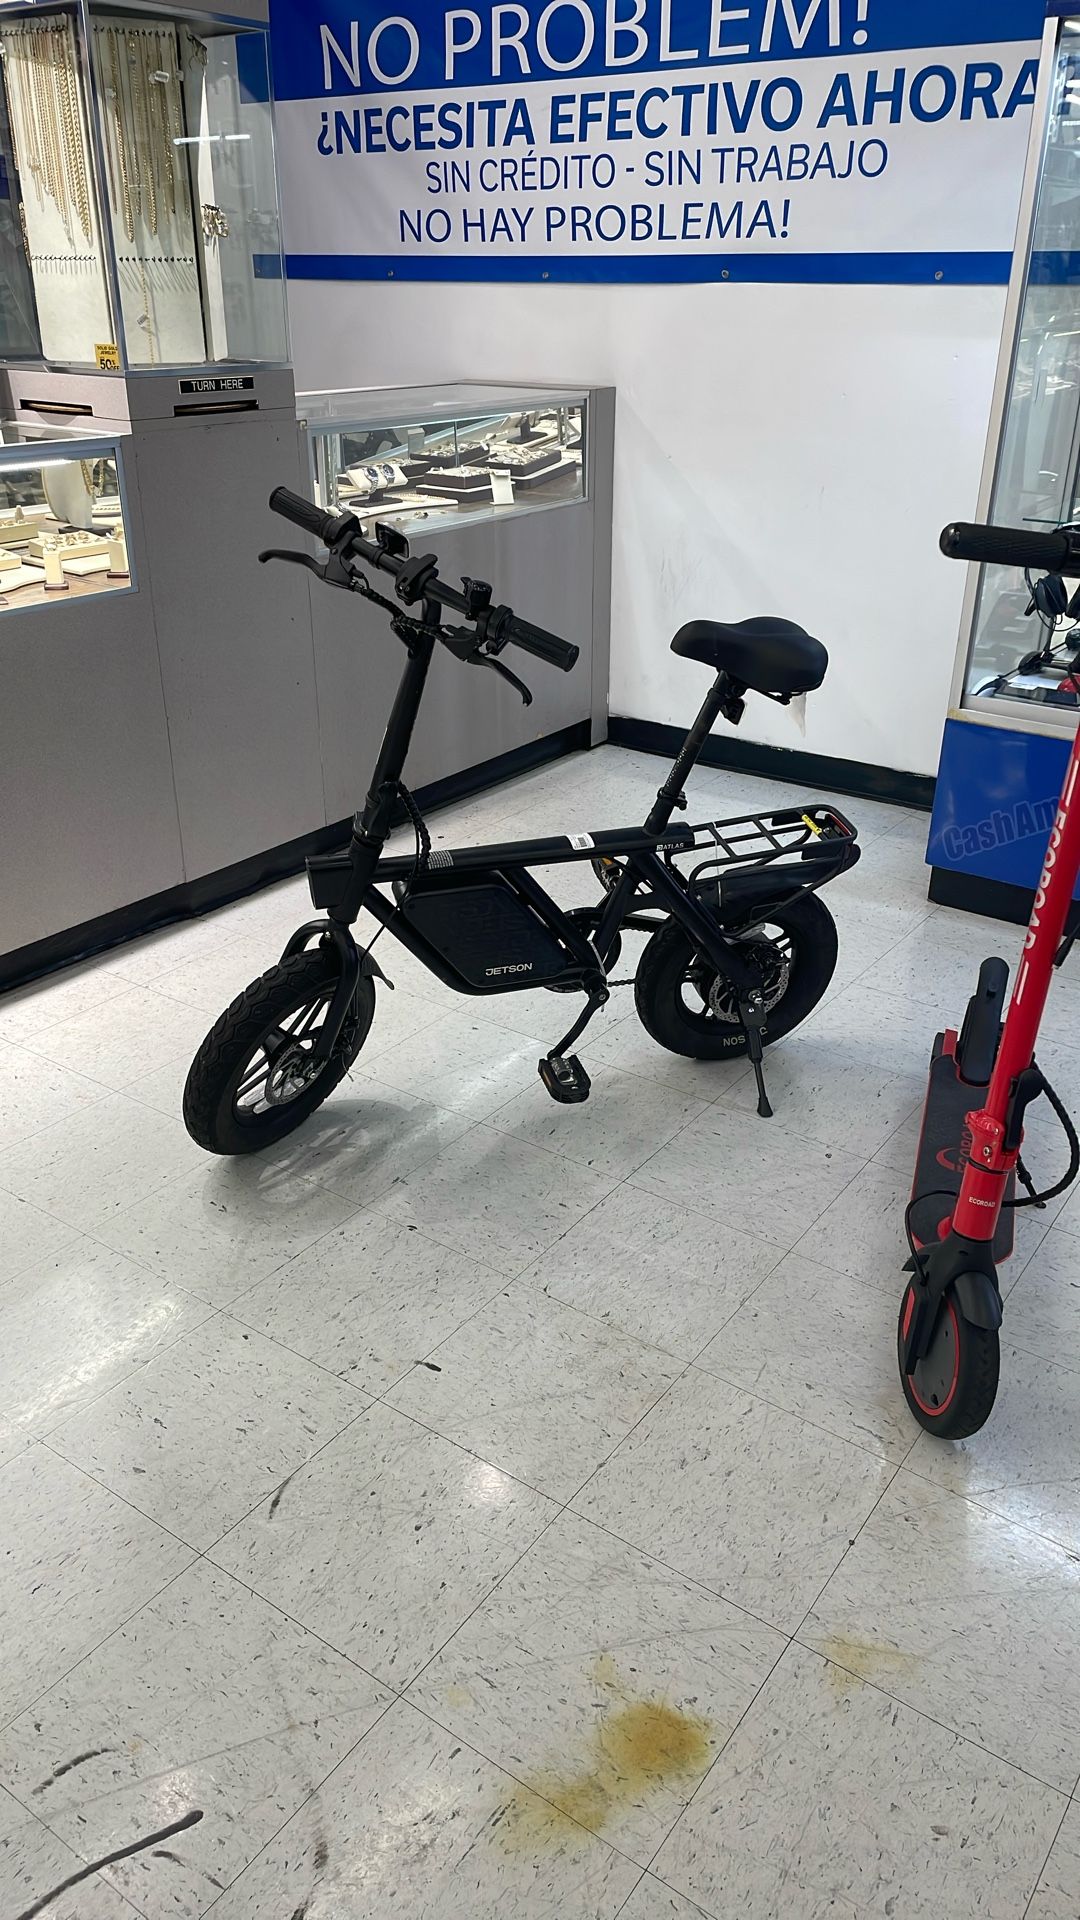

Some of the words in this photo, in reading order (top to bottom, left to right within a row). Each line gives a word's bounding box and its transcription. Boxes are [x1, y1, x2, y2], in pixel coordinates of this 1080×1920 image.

[319, 16, 420, 90] NO
[445, 0, 868, 81] PROBLEM!
[317, 98, 535, 156] ¿NECESITA
[550, 77, 803, 144] EFECTIVO
[426, 160, 471, 194] SIN
[479, 150, 616, 193] CRÉDITO
[644, 150, 701, 187] SIN
[711, 139, 888, 184] TRABAJO
[399, 208, 452, 243] NO
[462, 207, 534, 242] HAY
[546, 199, 790, 242] PROBLEMA!
[191, 380, 216, 391] TURN
[220, 379, 244, 390] HERE
[663, 842, 685, 850] ATLAS
[485, 962, 533, 976] JETSON
